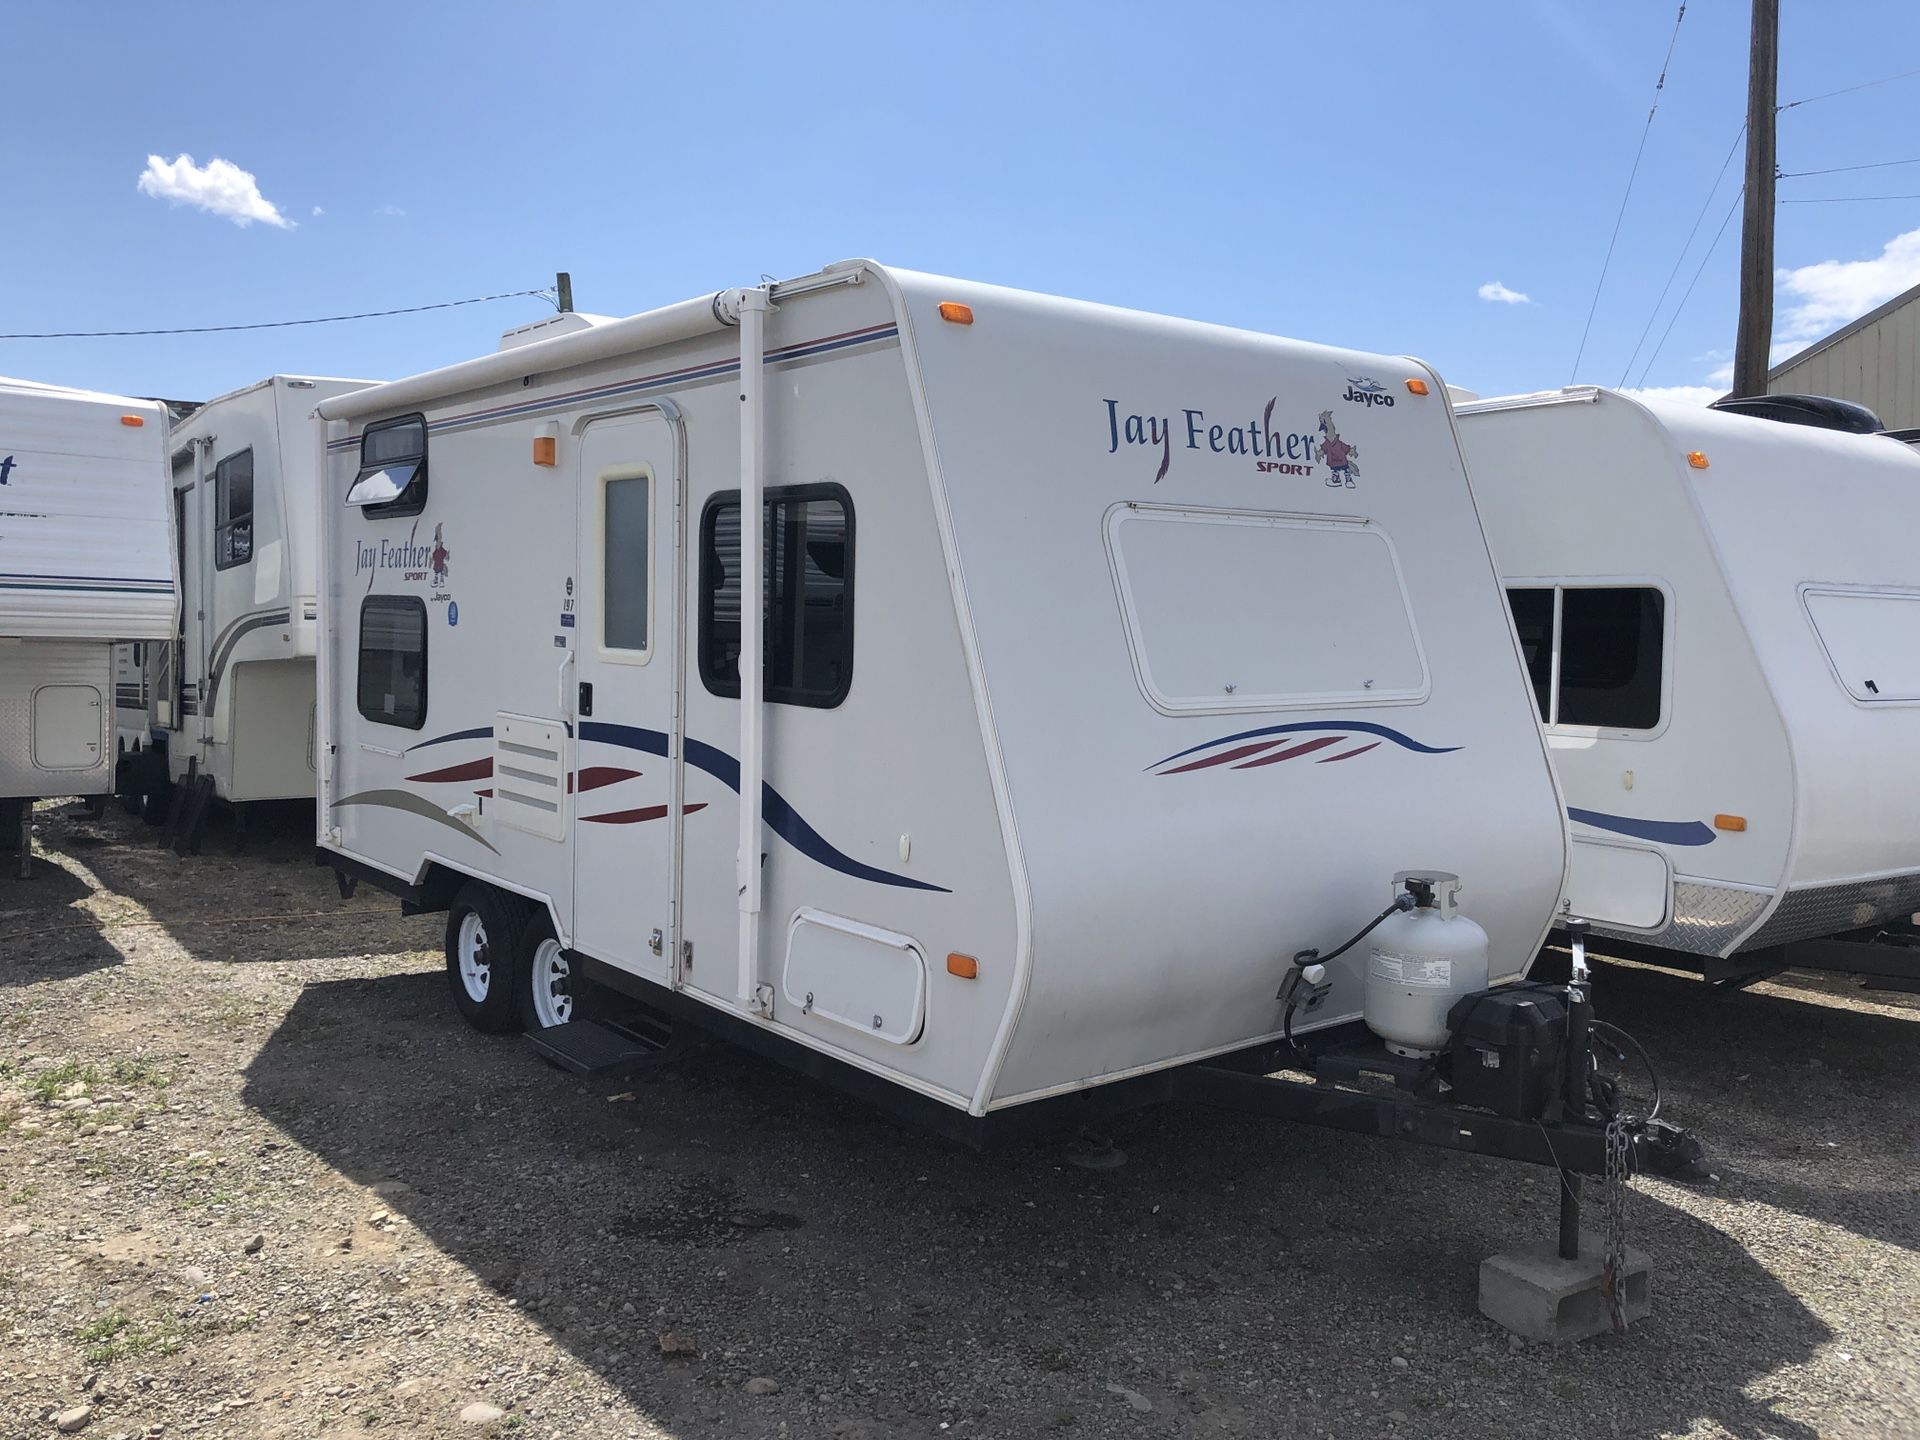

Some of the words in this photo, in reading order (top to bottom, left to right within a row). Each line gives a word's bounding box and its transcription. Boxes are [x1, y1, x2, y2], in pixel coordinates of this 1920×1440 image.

[1342, 386, 1395, 408] Jayco
[1102, 398, 1170, 484] Jay
[1181, 396, 1315, 461] Feather
[1256, 461, 1314, 477] SPORT
[355, 540, 376, 594] Jay
[380, 519, 431, 569] Feather
[403, 571, 428, 581] SPORT
[563, 598, 575, 612] 197
